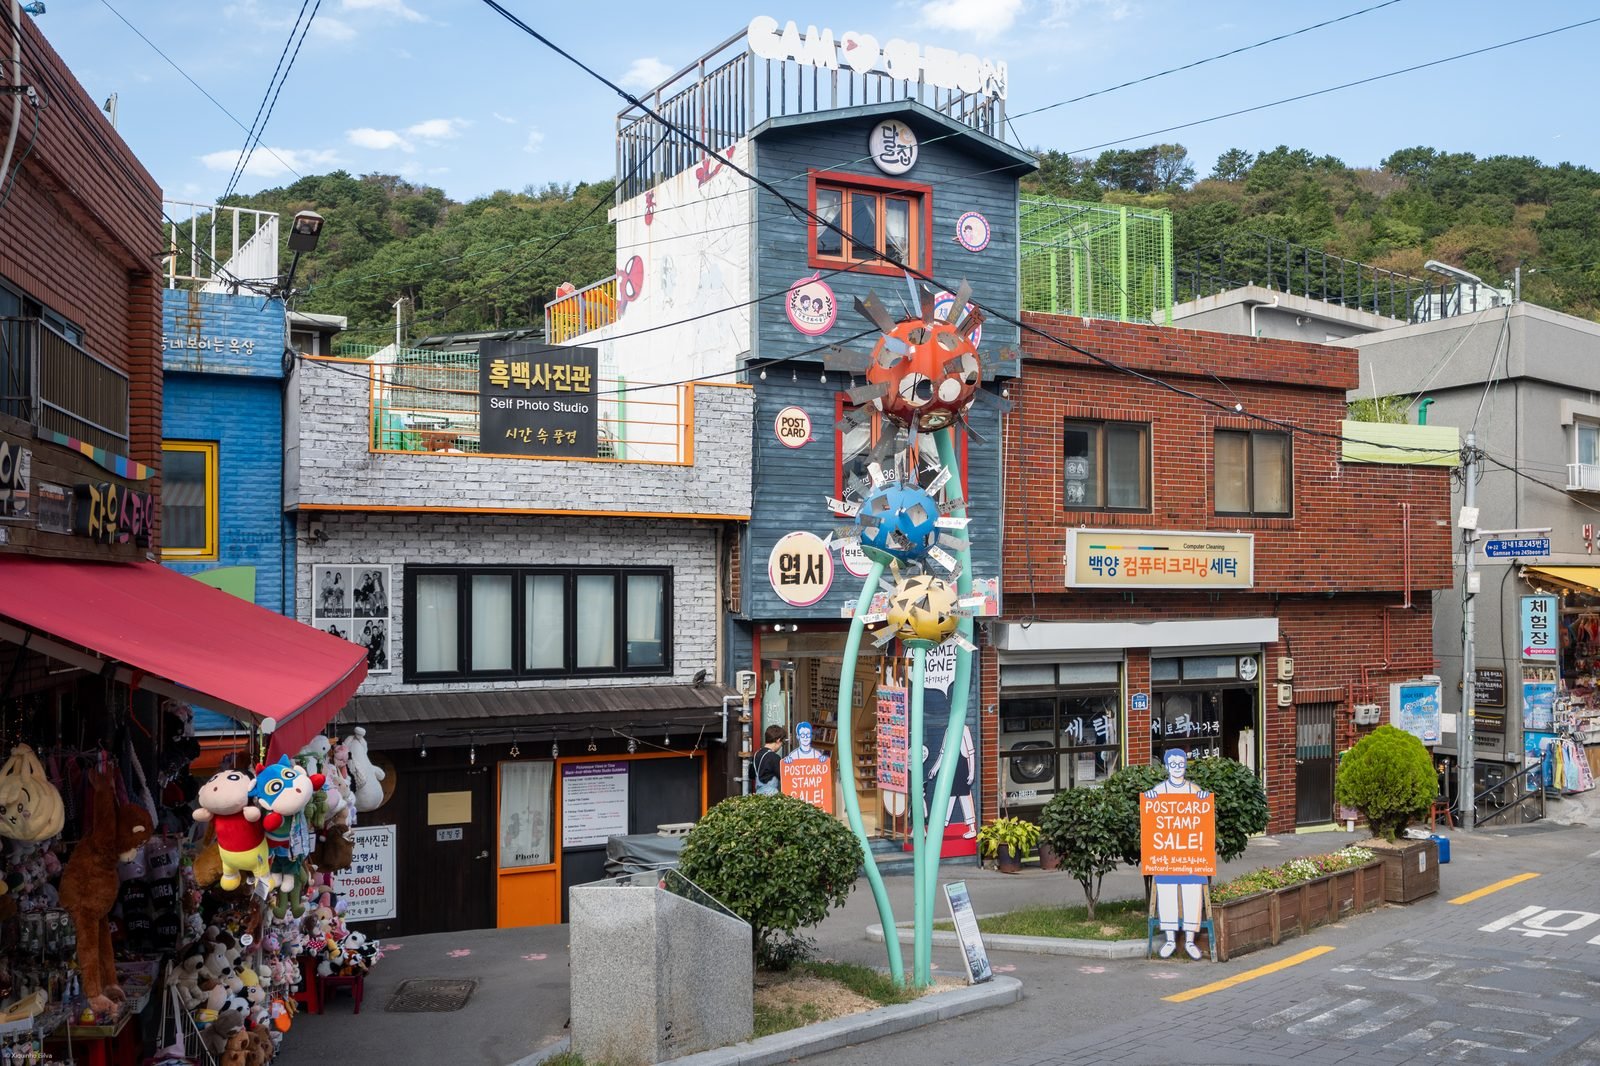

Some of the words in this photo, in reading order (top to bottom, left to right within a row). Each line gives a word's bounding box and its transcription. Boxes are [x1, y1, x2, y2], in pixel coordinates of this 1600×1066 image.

[187, 336, 224, 353] 보이는
[229, 338, 255, 355] 옥상
[489, 359, 592, 393] 흑백사진관
[490, 397, 513, 410] Self
[516, 400, 550, 411] Photo
[553, 401, 589, 413] Studio
[781, 417, 806, 428] POST
[505, 427, 533, 443] 시간
[537, 428, 549, 445] 속
[553, 429, 577, 445] 풍경
[780, 427, 806, 438] CARD
[1206, 543, 1225, 551] Cleaning
[779, 554, 824, 585] 엽서
[1089, 556, 1119, 577] 백양
[1124, 556, 1208, 577] 컴퓨터크리닝
[1210, 557, 1238, 578] 세탁
[1530, 600, 1549, 645] 체험장
[1065, 715, 1113, 746] 세탁
[784, 764, 828, 776] POSTCARD
[791, 776, 822, 788] STAMP
[1145, 800, 1210, 814] POSTCARD
[1156, 815, 1201, 829] STAMP
[1153, 831, 1203, 852] SALE!
[515, 852, 540, 861] Photo
[1145, 864, 1192, 874] Postcard-sending
